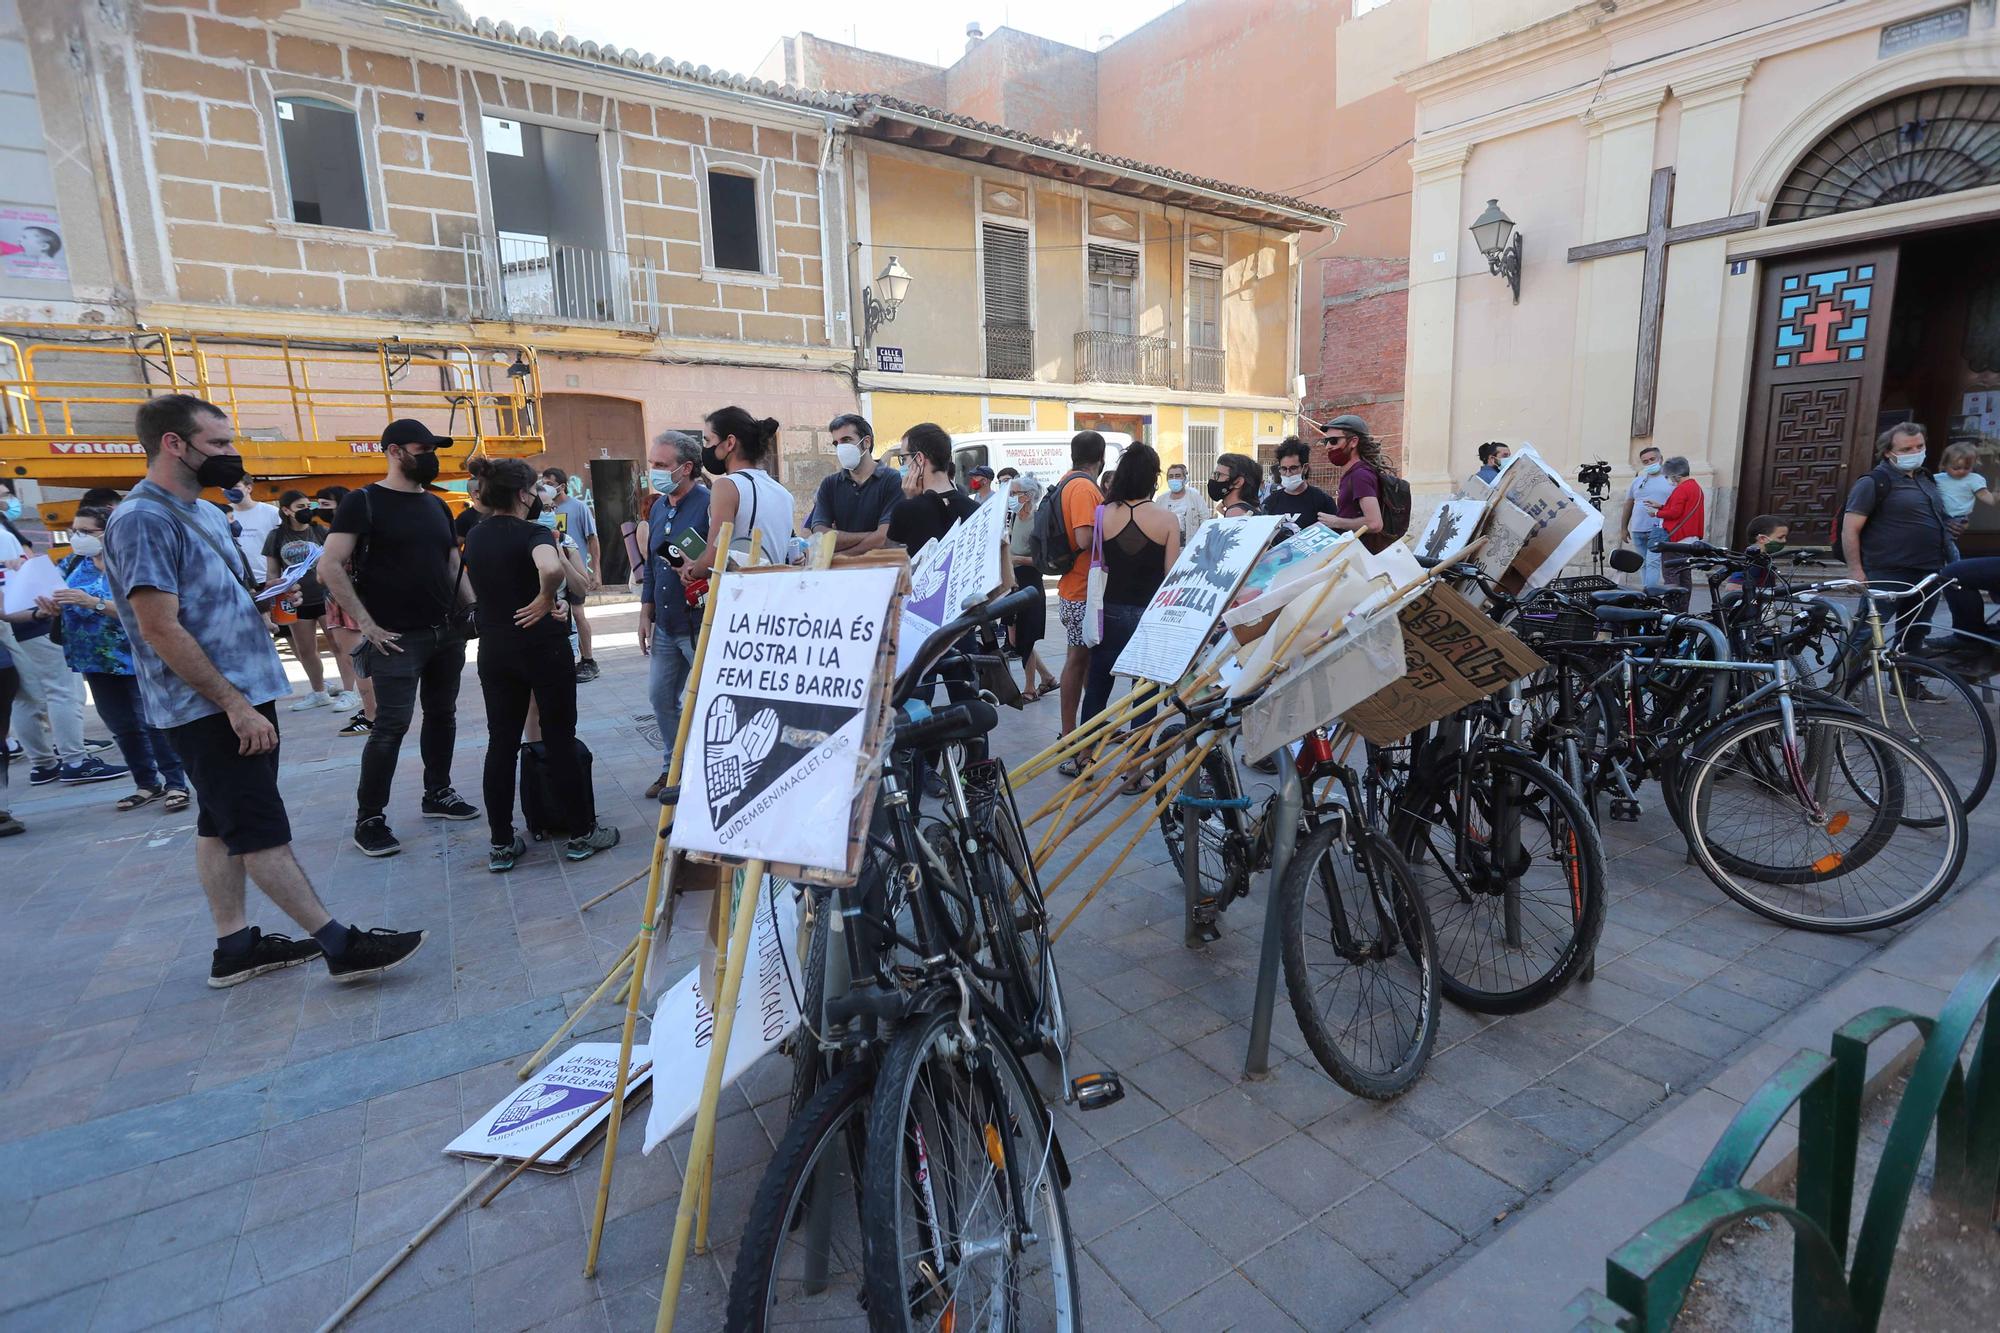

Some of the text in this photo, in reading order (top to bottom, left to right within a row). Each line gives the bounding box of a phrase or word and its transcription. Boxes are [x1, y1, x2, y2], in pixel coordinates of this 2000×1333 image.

[880, 349, 899, 357] CALLE
[351, 442, 371, 453] Telf.
[729, 613, 750, 634] LA
[756, 612, 843, 641] HISTÒRIA
[850, 615, 874, 642] ÉS
[723, 641, 840, 668] NOSTRA I LA
[716, 667, 864, 699] FEM ELS BARRIS
[718, 735, 849, 845] CUIDEMBENIMACLET.OG
[568, 1056, 583, 1064] LA
[555, 1065, 600, 1075] NOSTRA
[542, 1074, 569, 1083] FEM
[568, 1076, 588, 1085] ELS
